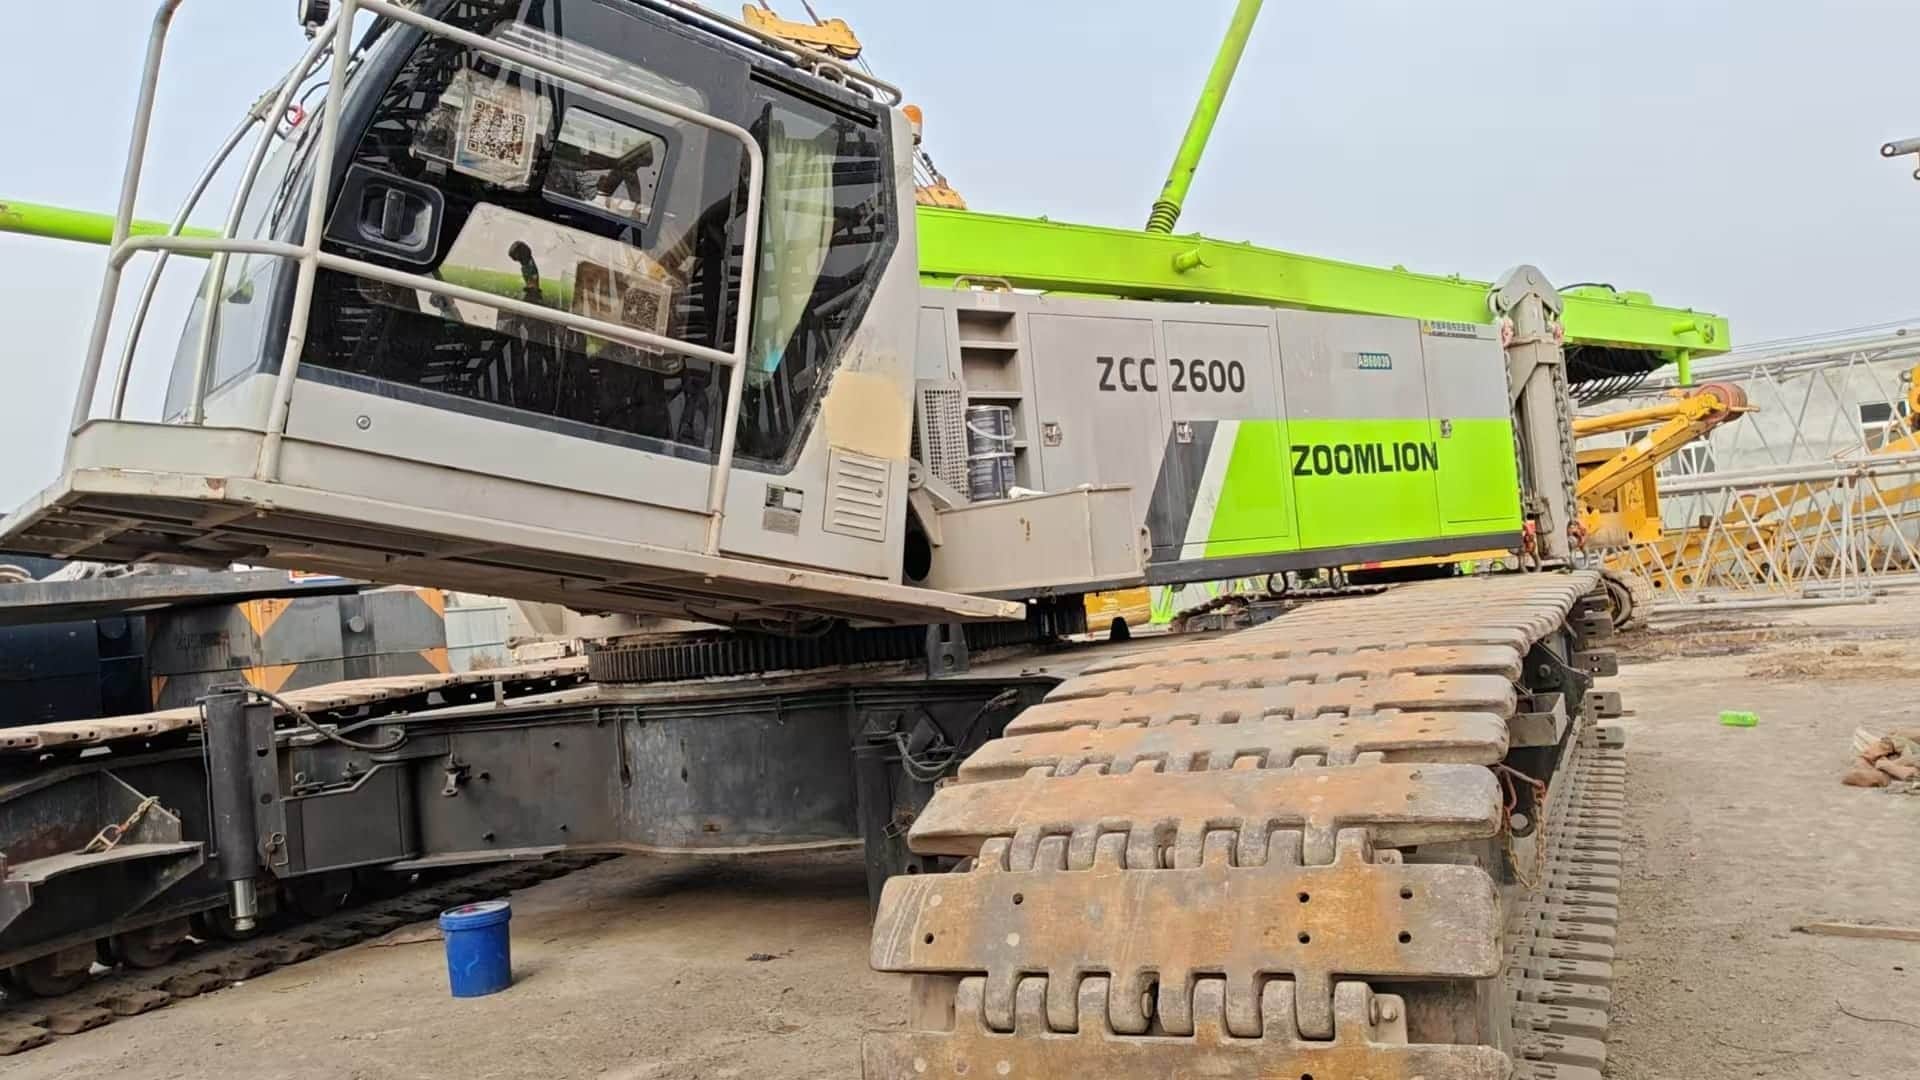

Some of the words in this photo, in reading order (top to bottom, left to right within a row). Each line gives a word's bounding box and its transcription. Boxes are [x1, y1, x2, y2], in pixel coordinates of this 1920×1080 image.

[1096, 356, 1158, 392] ZCC
[1169, 358, 1245, 393] 2600
[1290, 441, 1439, 477] ZOOMLION
